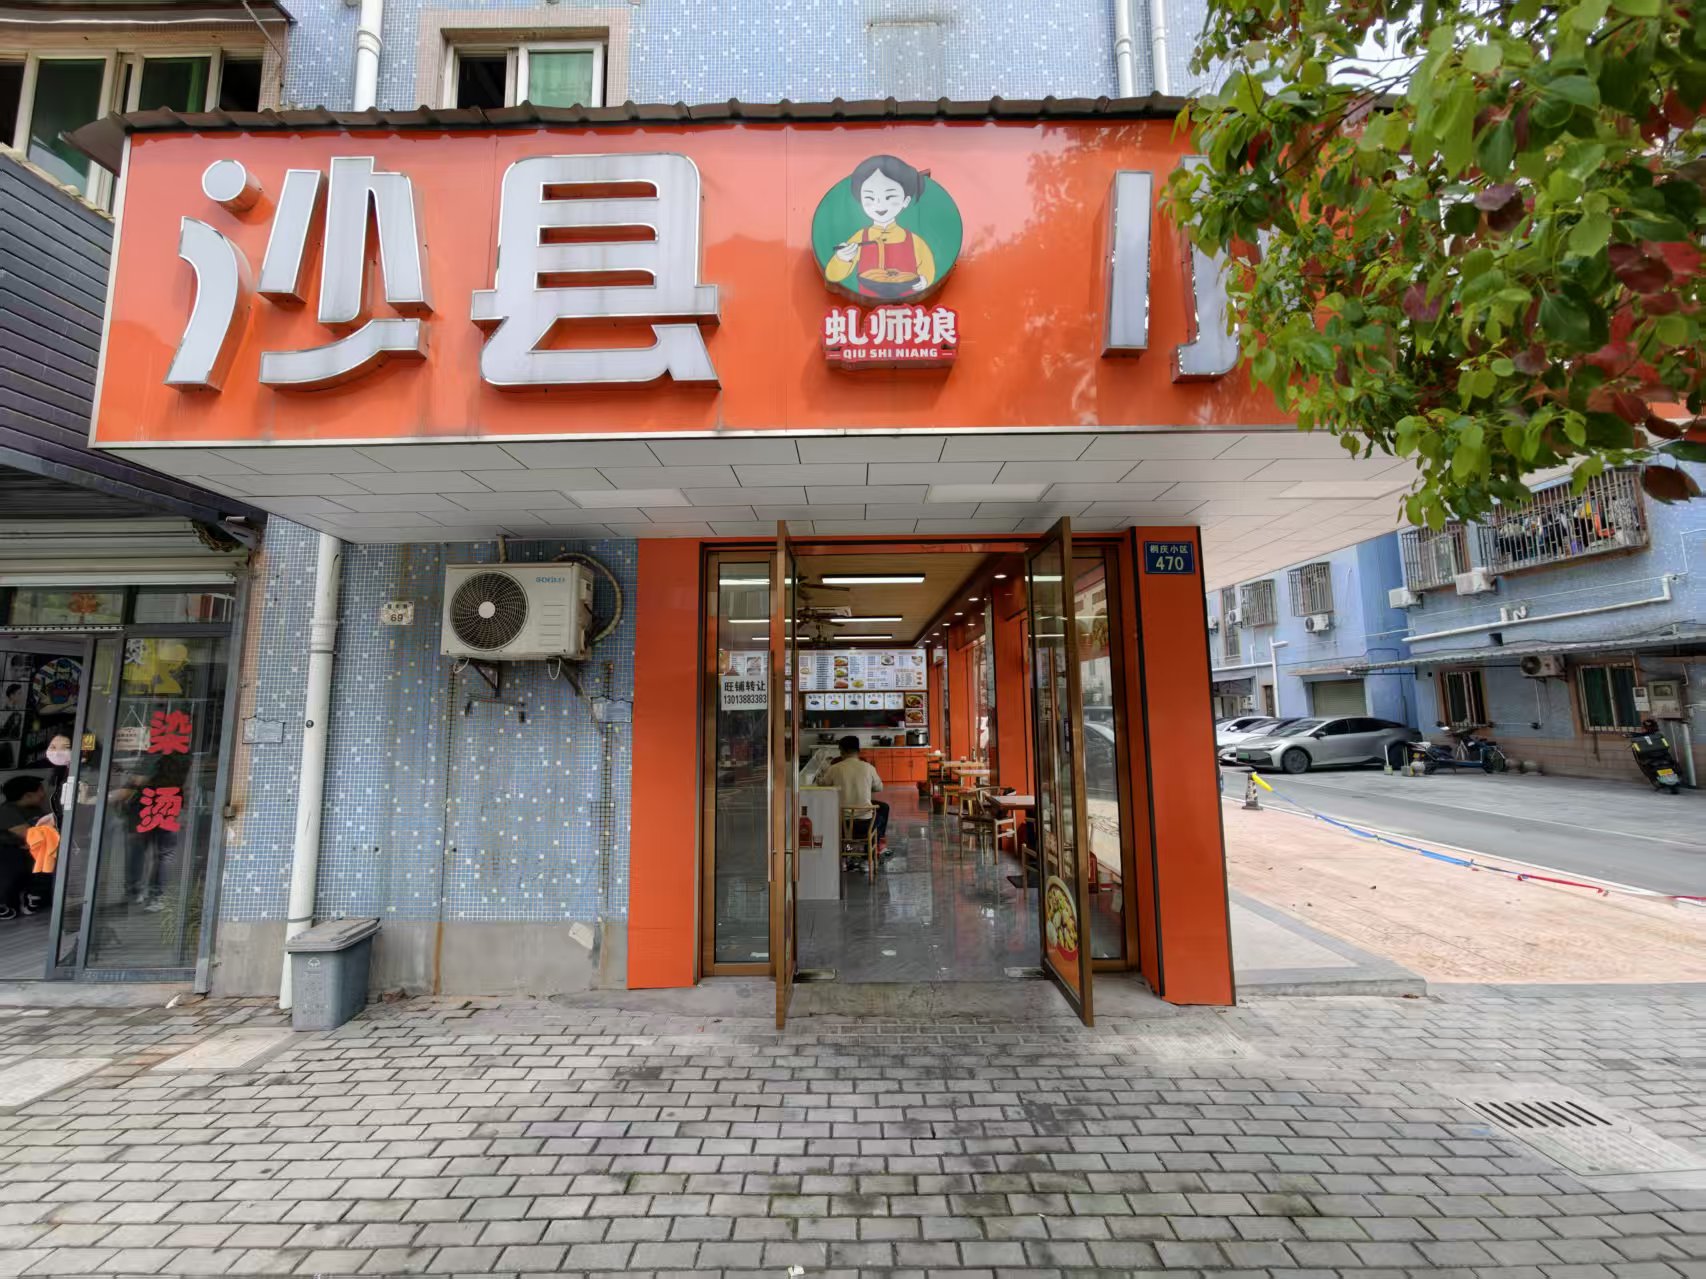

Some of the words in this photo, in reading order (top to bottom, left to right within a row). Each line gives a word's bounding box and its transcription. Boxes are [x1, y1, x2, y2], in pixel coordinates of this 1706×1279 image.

[165, 153, 722, 388] 沙县
[825, 308, 957, 345] 虬师娘
[843, 349, 866, 359] QIU
[870, 349, 892, 358] SHI
[895, 348, 938, 358] NIANG
[1156, 556, 1184, 570] 470
[724, 680, 766, 691] 旺铺转让
